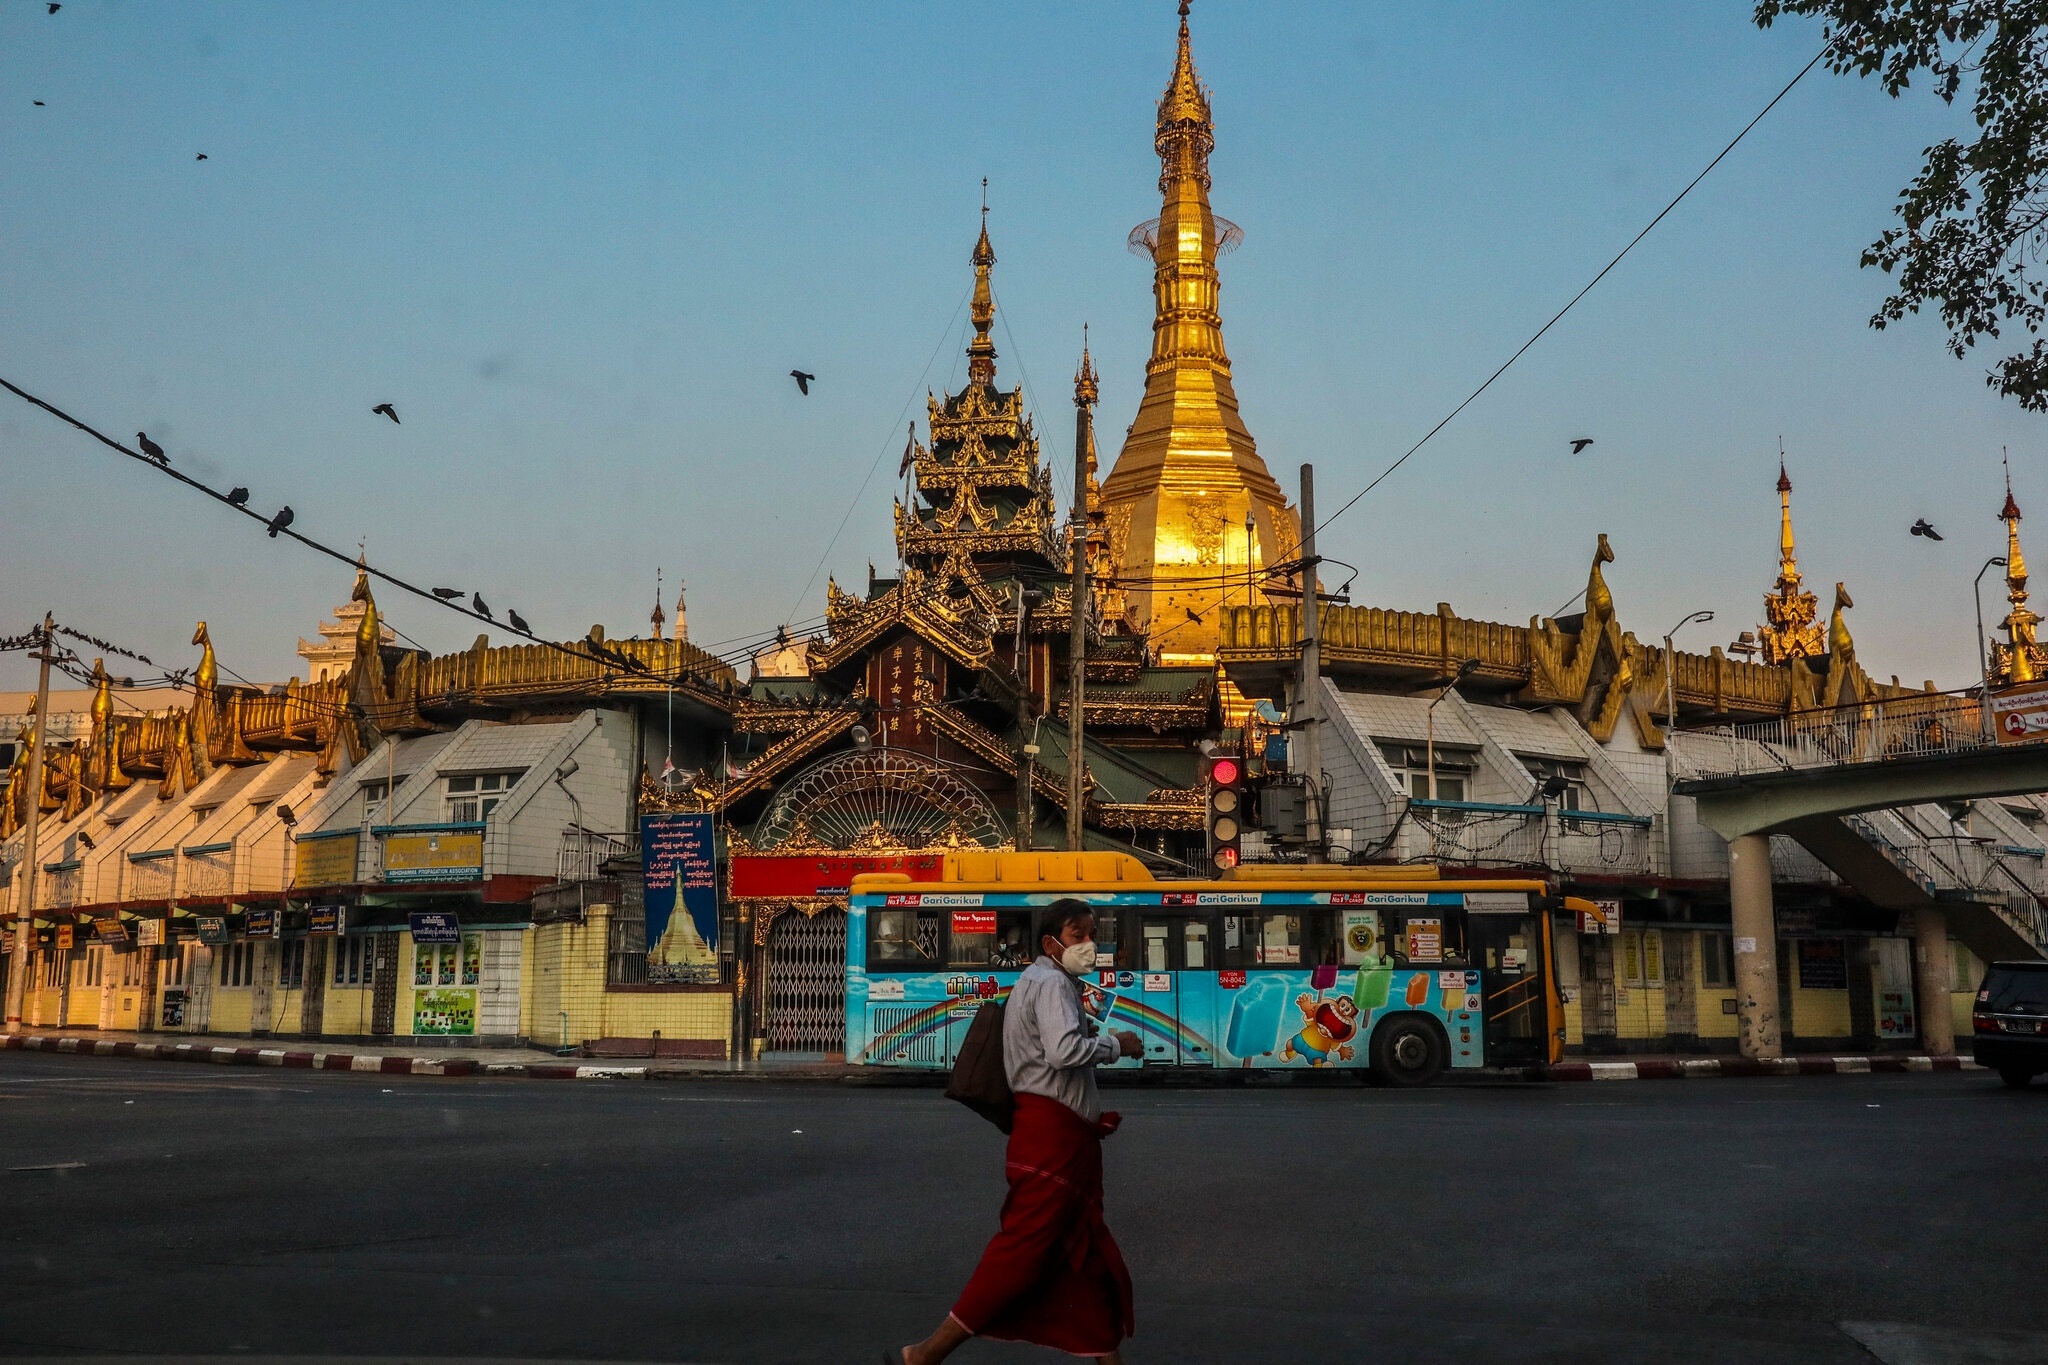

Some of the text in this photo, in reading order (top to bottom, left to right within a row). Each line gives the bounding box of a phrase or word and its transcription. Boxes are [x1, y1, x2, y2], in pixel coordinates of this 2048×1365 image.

[1226, 850, 1235, 866] 4
[922, 896, 980, 905] GariGarikun
[1199, 895, 1259, 904] GariGarikun
[1367, 895, 1425, 903] GariGarikun
[953, 913, 995, 923] Star Space
[1219, 976, 1246, 984] 5N-8042
